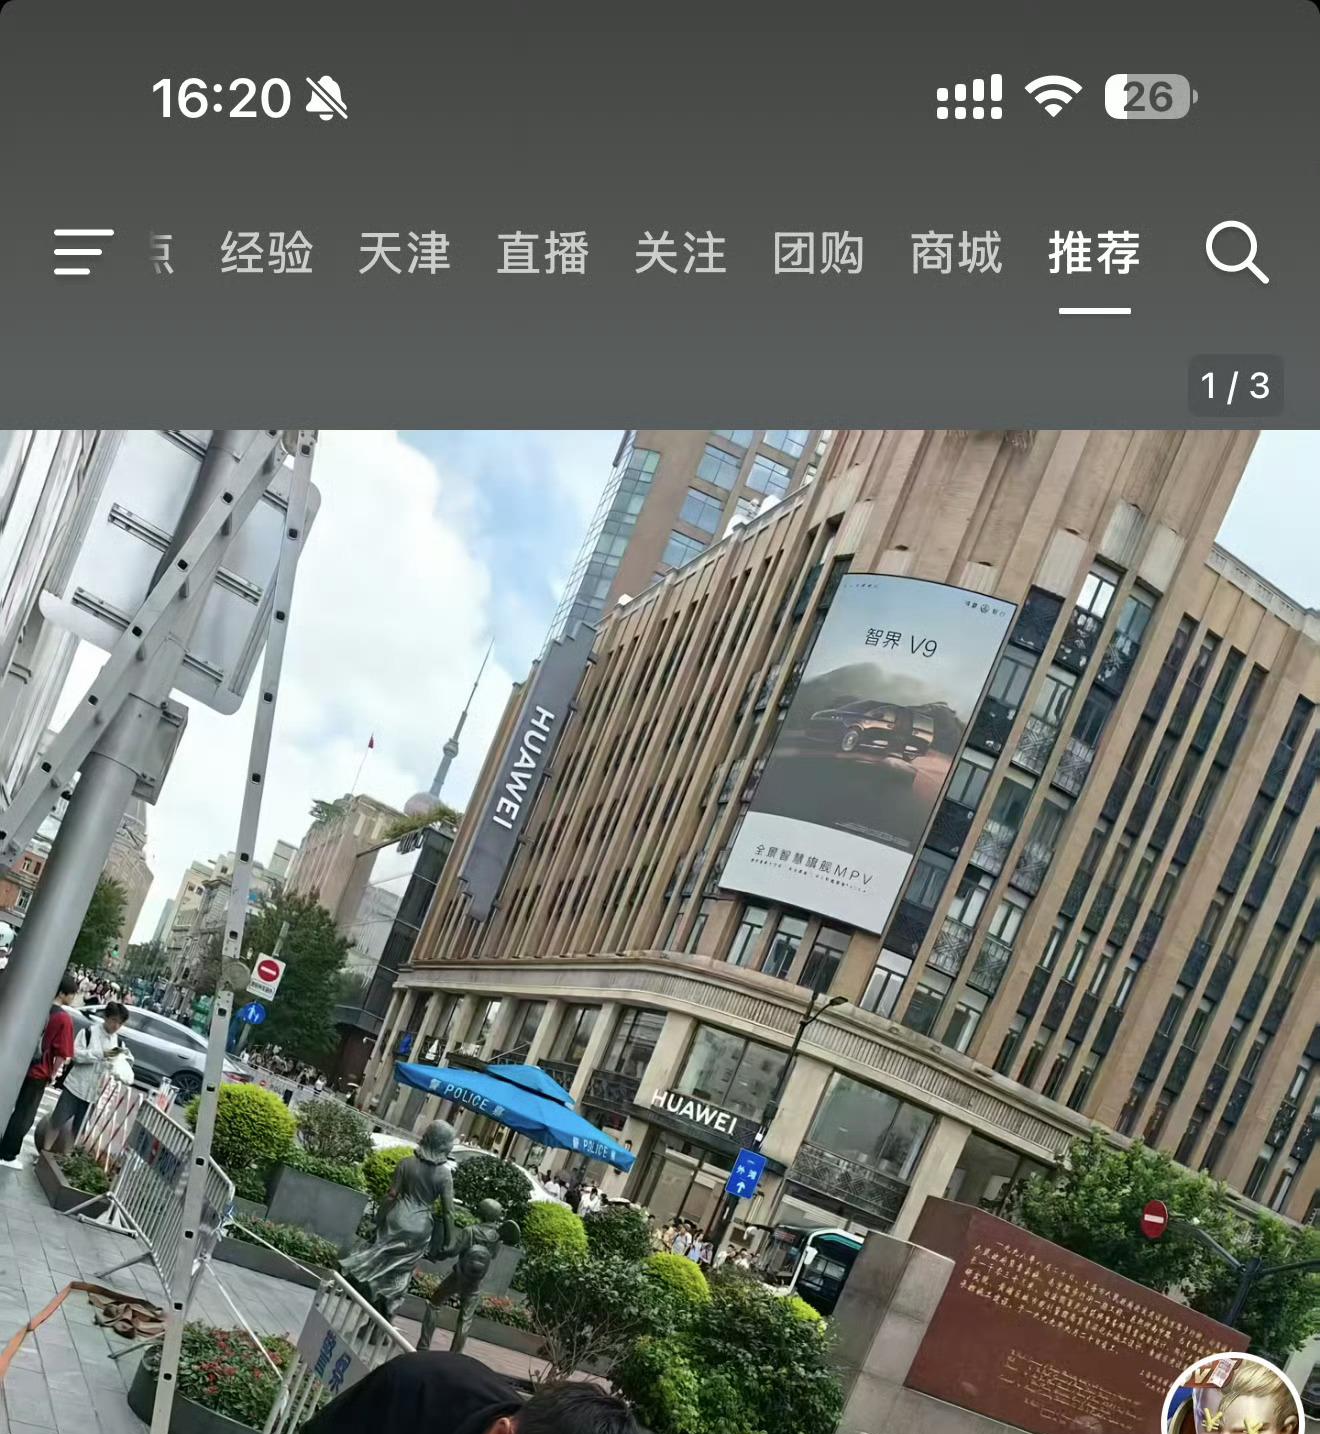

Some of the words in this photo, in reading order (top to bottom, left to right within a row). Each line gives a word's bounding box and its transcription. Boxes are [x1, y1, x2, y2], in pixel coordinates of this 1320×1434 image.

[864, 627, 903, 651] 智界
[910, 634, 938, 658] V9
[492, 705, 556, 830] HUAWEI
[443, 1083, 490, 1114] POLICE
[650, 1088, 738, 1137] HUAWEI
[582, 1137, 609, 1159] POLICE
